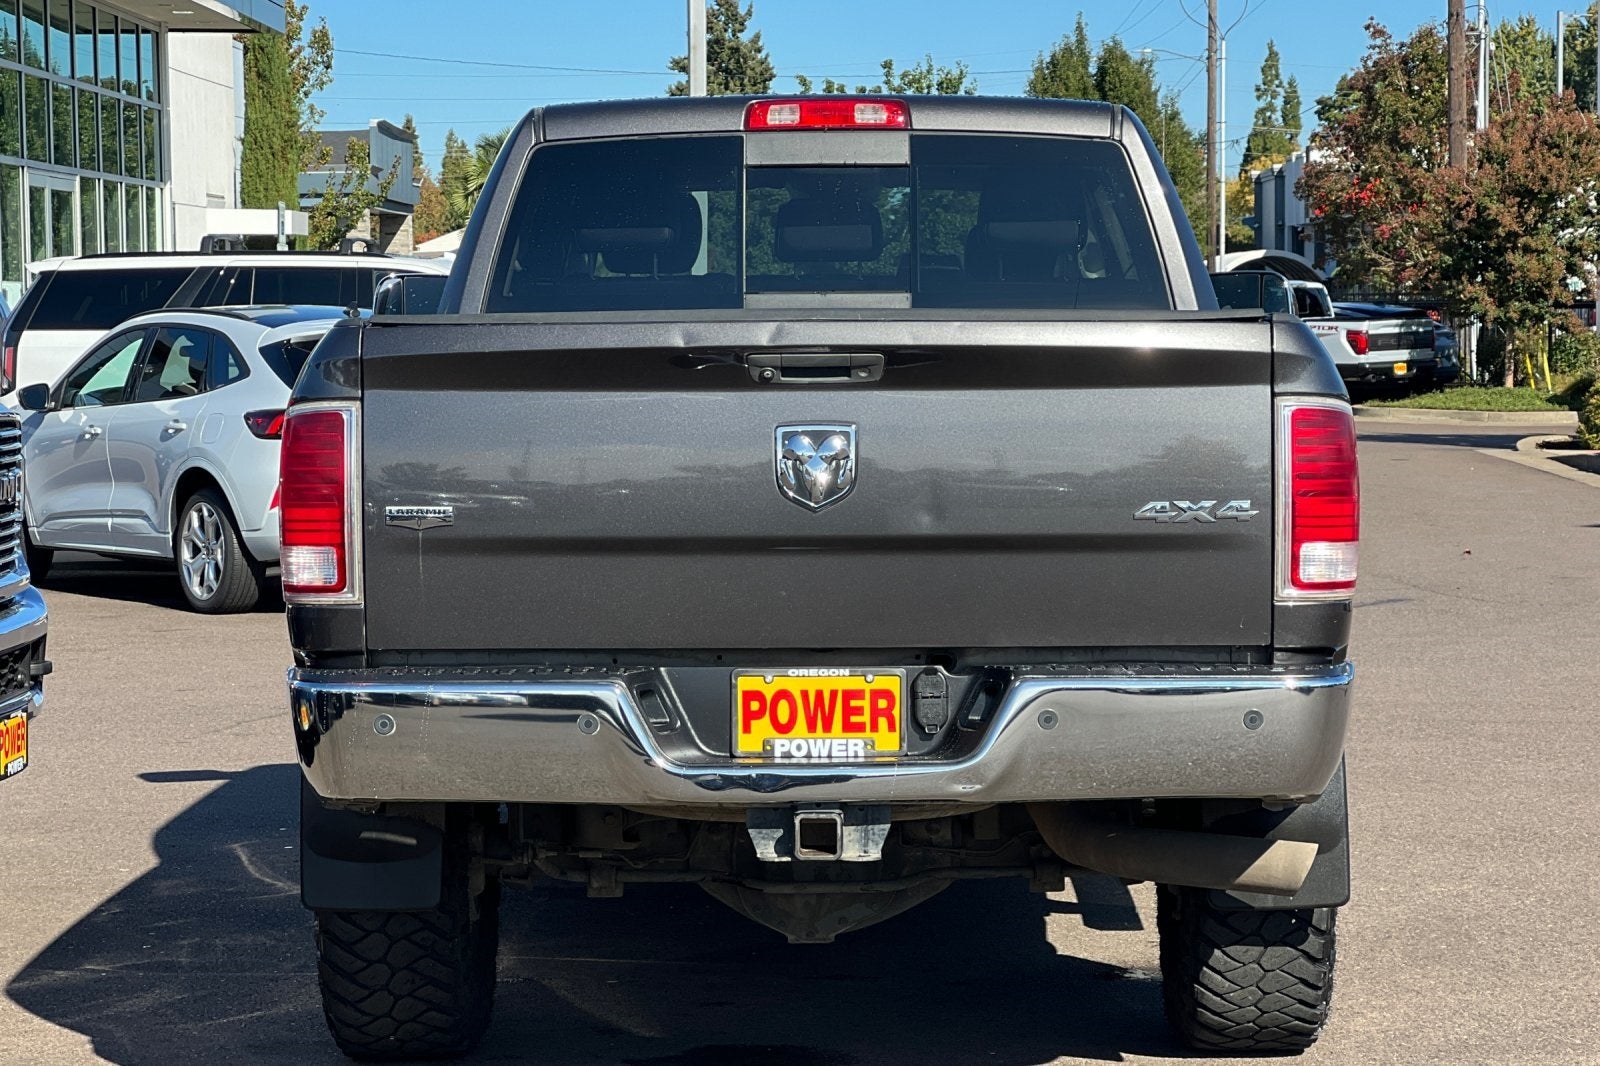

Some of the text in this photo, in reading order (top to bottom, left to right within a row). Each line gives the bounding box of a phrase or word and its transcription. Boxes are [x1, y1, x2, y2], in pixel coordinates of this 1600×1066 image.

[787, 668, 850, 677] OREGON
[741, 688, 897, 735] POWER
[773, 738, 865, 758] POWER
